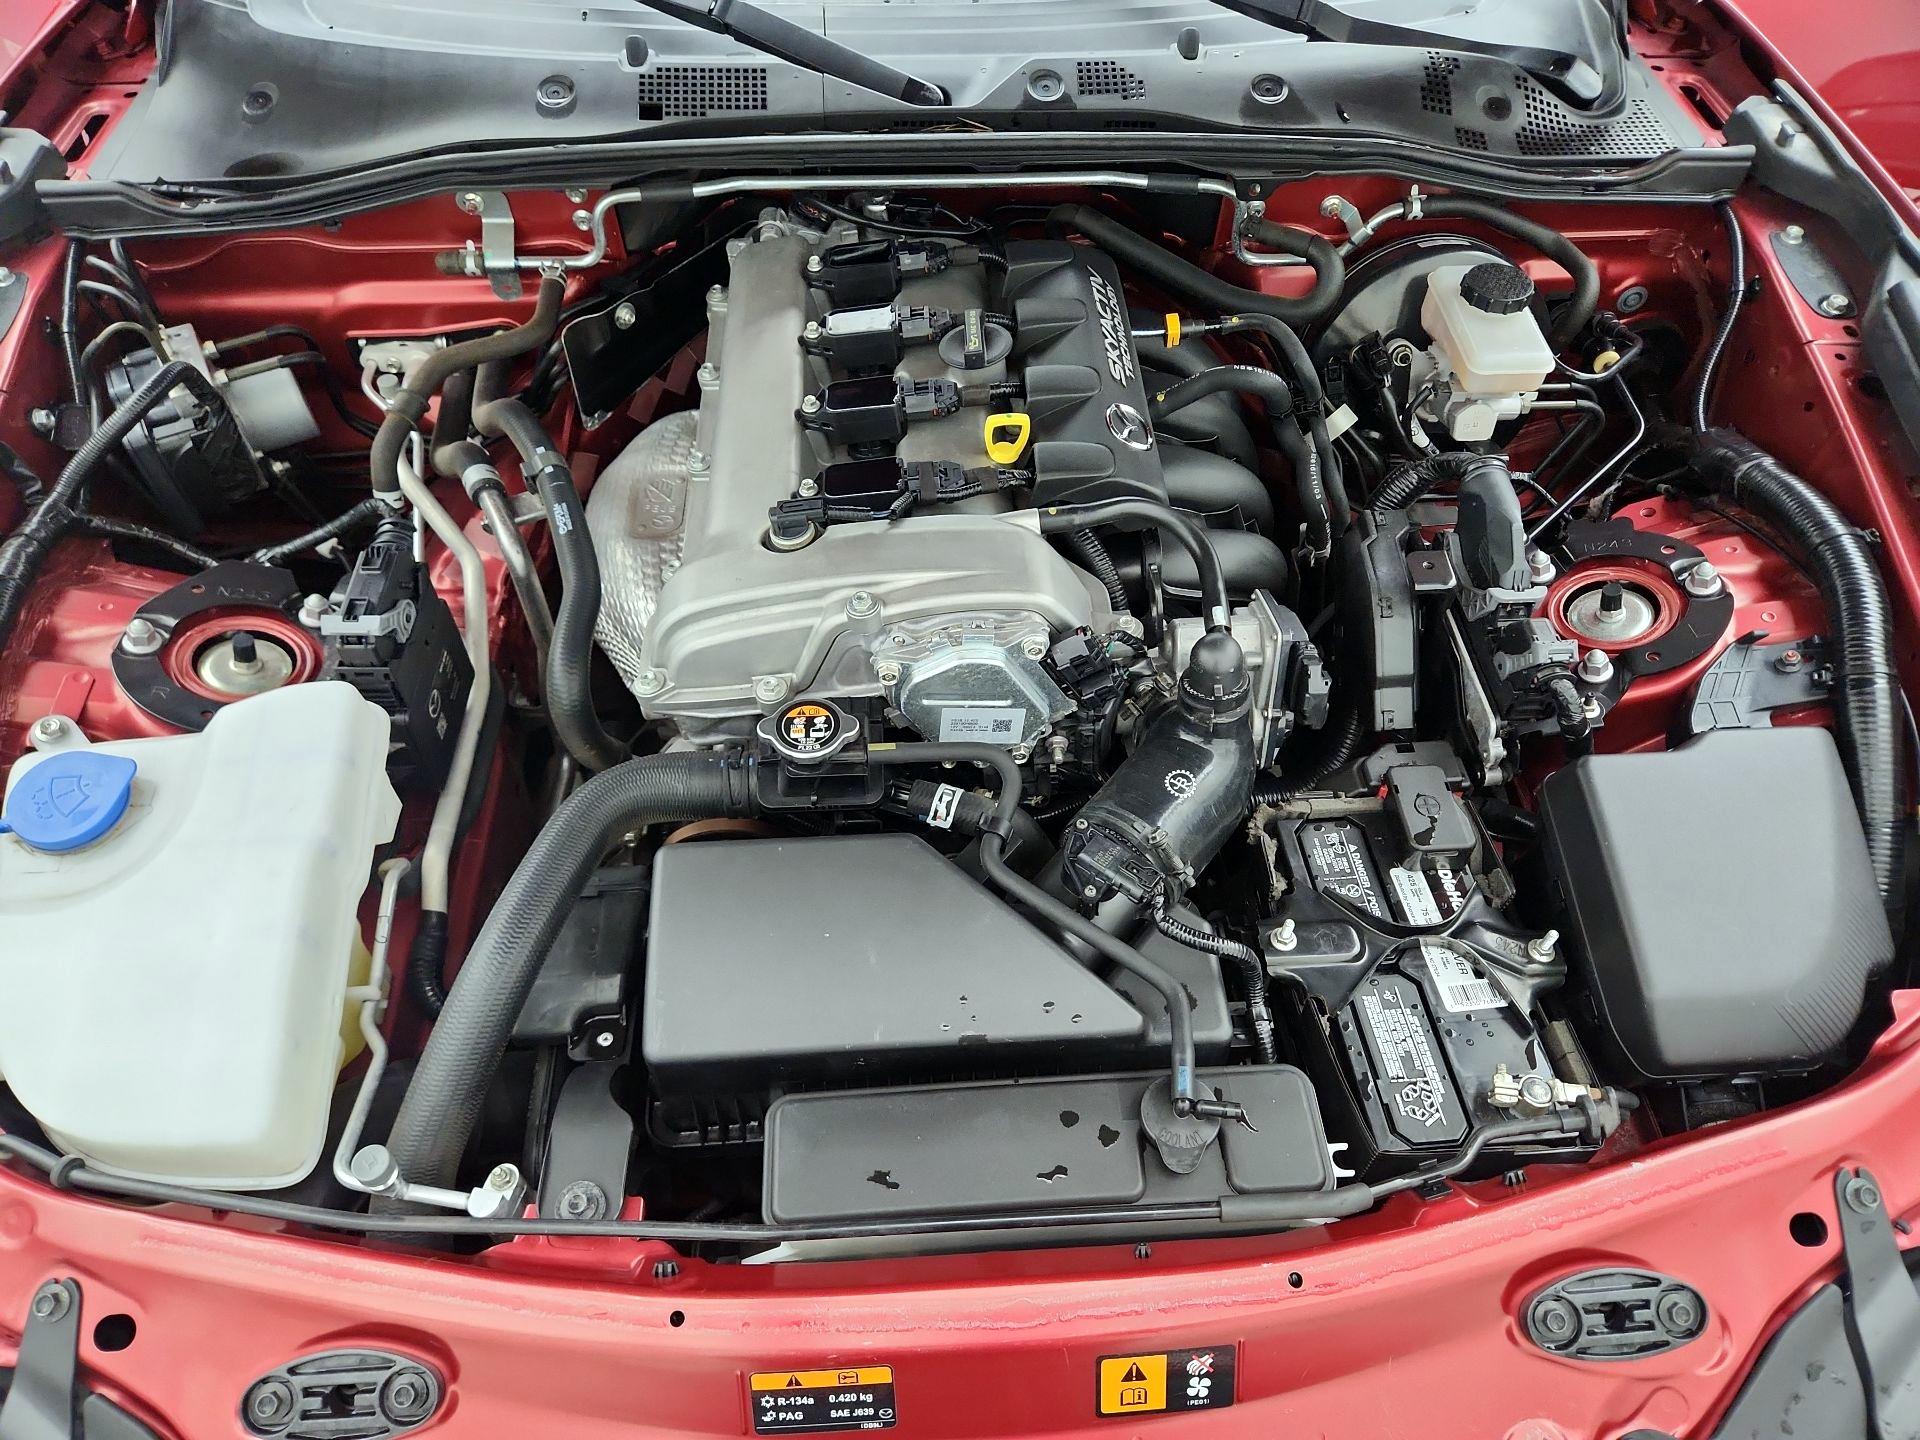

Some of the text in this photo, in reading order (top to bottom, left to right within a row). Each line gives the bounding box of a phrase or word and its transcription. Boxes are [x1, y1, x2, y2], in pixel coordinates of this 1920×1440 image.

[1086, 264, 1127, 388] SKYACTIV
[1105, 280, 1135, 380] TECHNOLOGY
[1350, 853, 1371, 887] DANGER
[1367, 896, 1381, 916] POIS
[778, 1392, 873, 1406] R-134a 0.420 kg
[778, 1408, 874, 1420] PAG SAE J639
